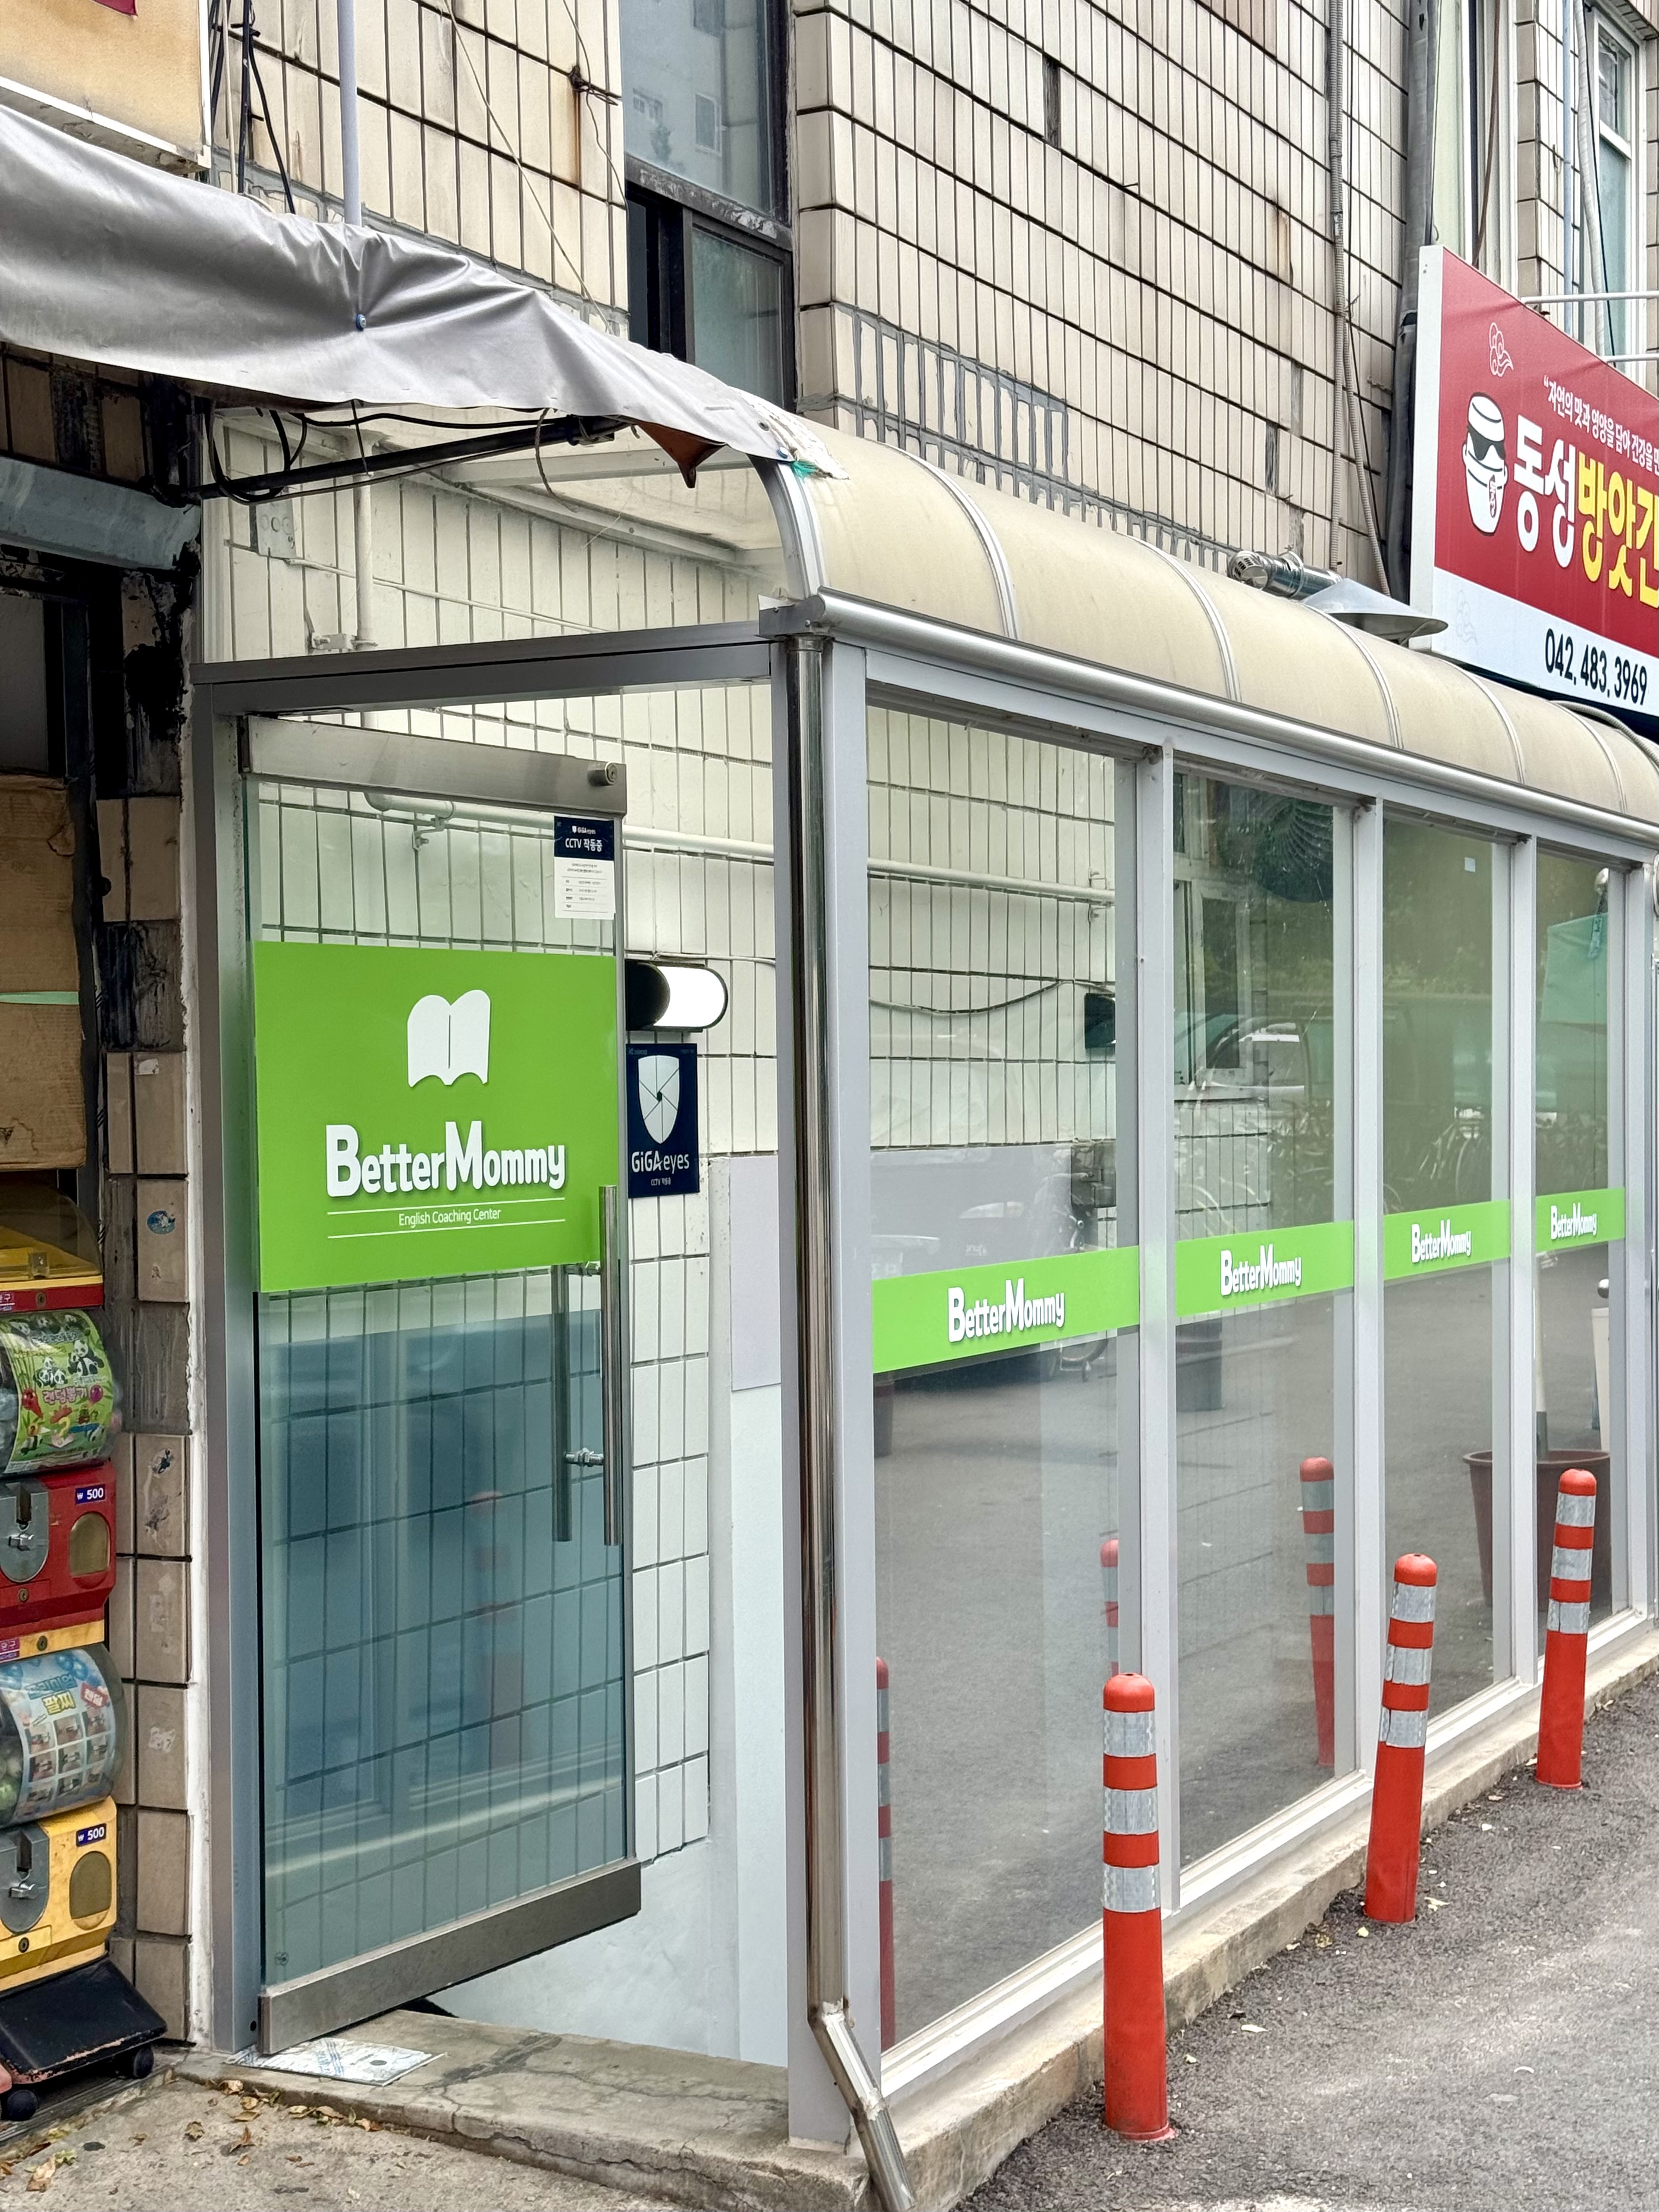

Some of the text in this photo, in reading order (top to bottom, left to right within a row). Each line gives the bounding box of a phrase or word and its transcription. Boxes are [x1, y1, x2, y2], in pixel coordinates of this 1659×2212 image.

[1574, 396, 1591, 434] 맛과
[1591, 409, 1615, 449] 영양을
[1615, 423, 1630, 459] 담아
[1631, 434, 1653, 473] 건강을
[565, 837, 603, 852] CCTV 작동중
[325, 1120, 566, 1198] BetterMommy
[399, 1208, 501, 1228] English Coaching Center
[1550, 1202, 1597, 1240] BetterMommy
[1411, 1219, 1472, 1263] BetterMommy
[1221, 1244, 1302, 1295] BetterMommy
[948, 1278, 1065, 1342] BetterMommy
[87, 1488, 104, 1499] 500
[87, 1827, 105, 1841] 500
